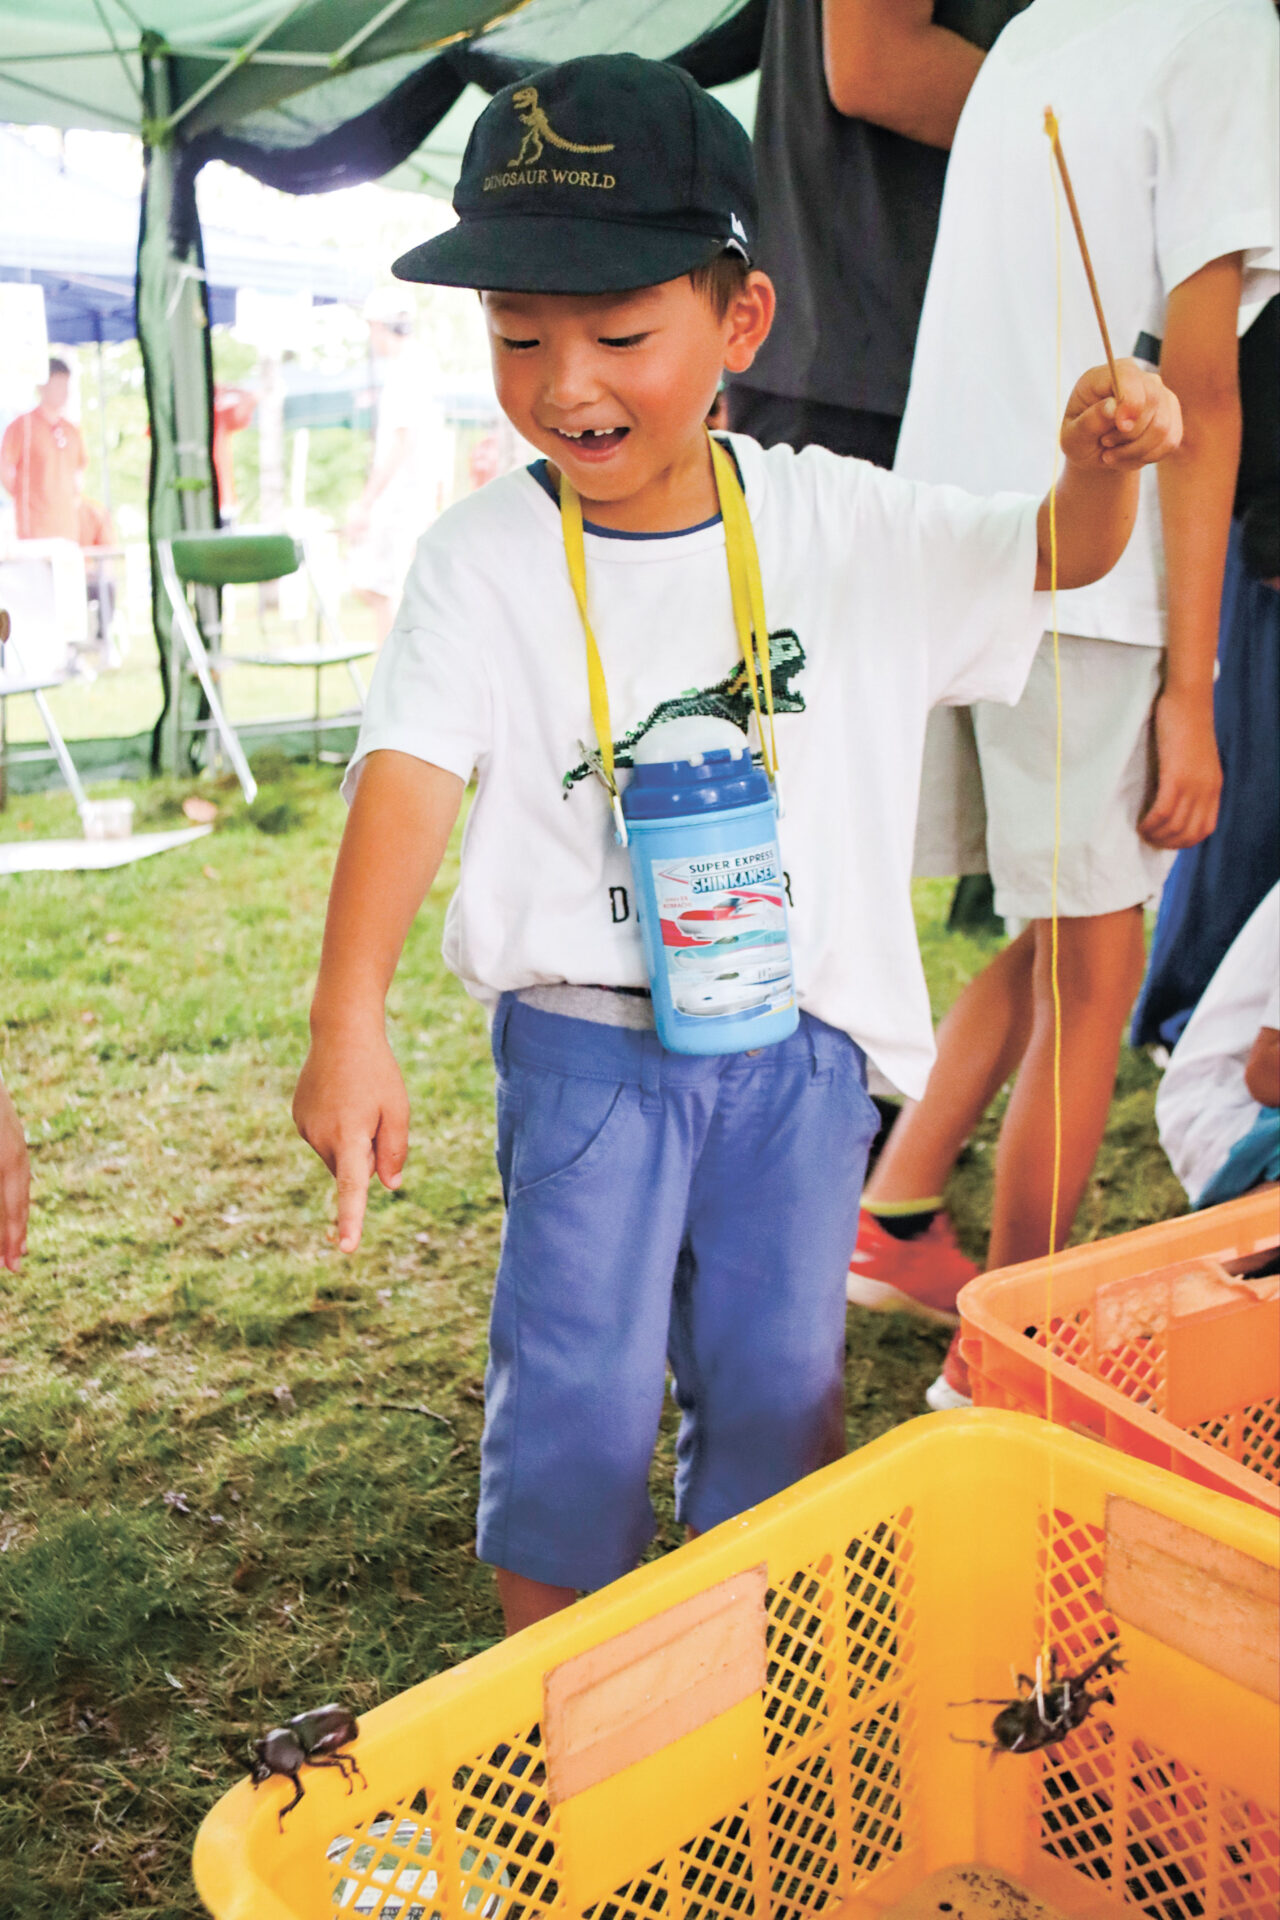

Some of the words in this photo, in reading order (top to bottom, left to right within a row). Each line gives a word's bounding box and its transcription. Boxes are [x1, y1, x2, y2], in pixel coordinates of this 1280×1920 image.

[483, 169, 548, 192] DINOSAUR
[551, 169, 616, 189] WORLD
[689, 860, 730, 874] SUPER
[735, 849, 774, 866] EXPRESS
